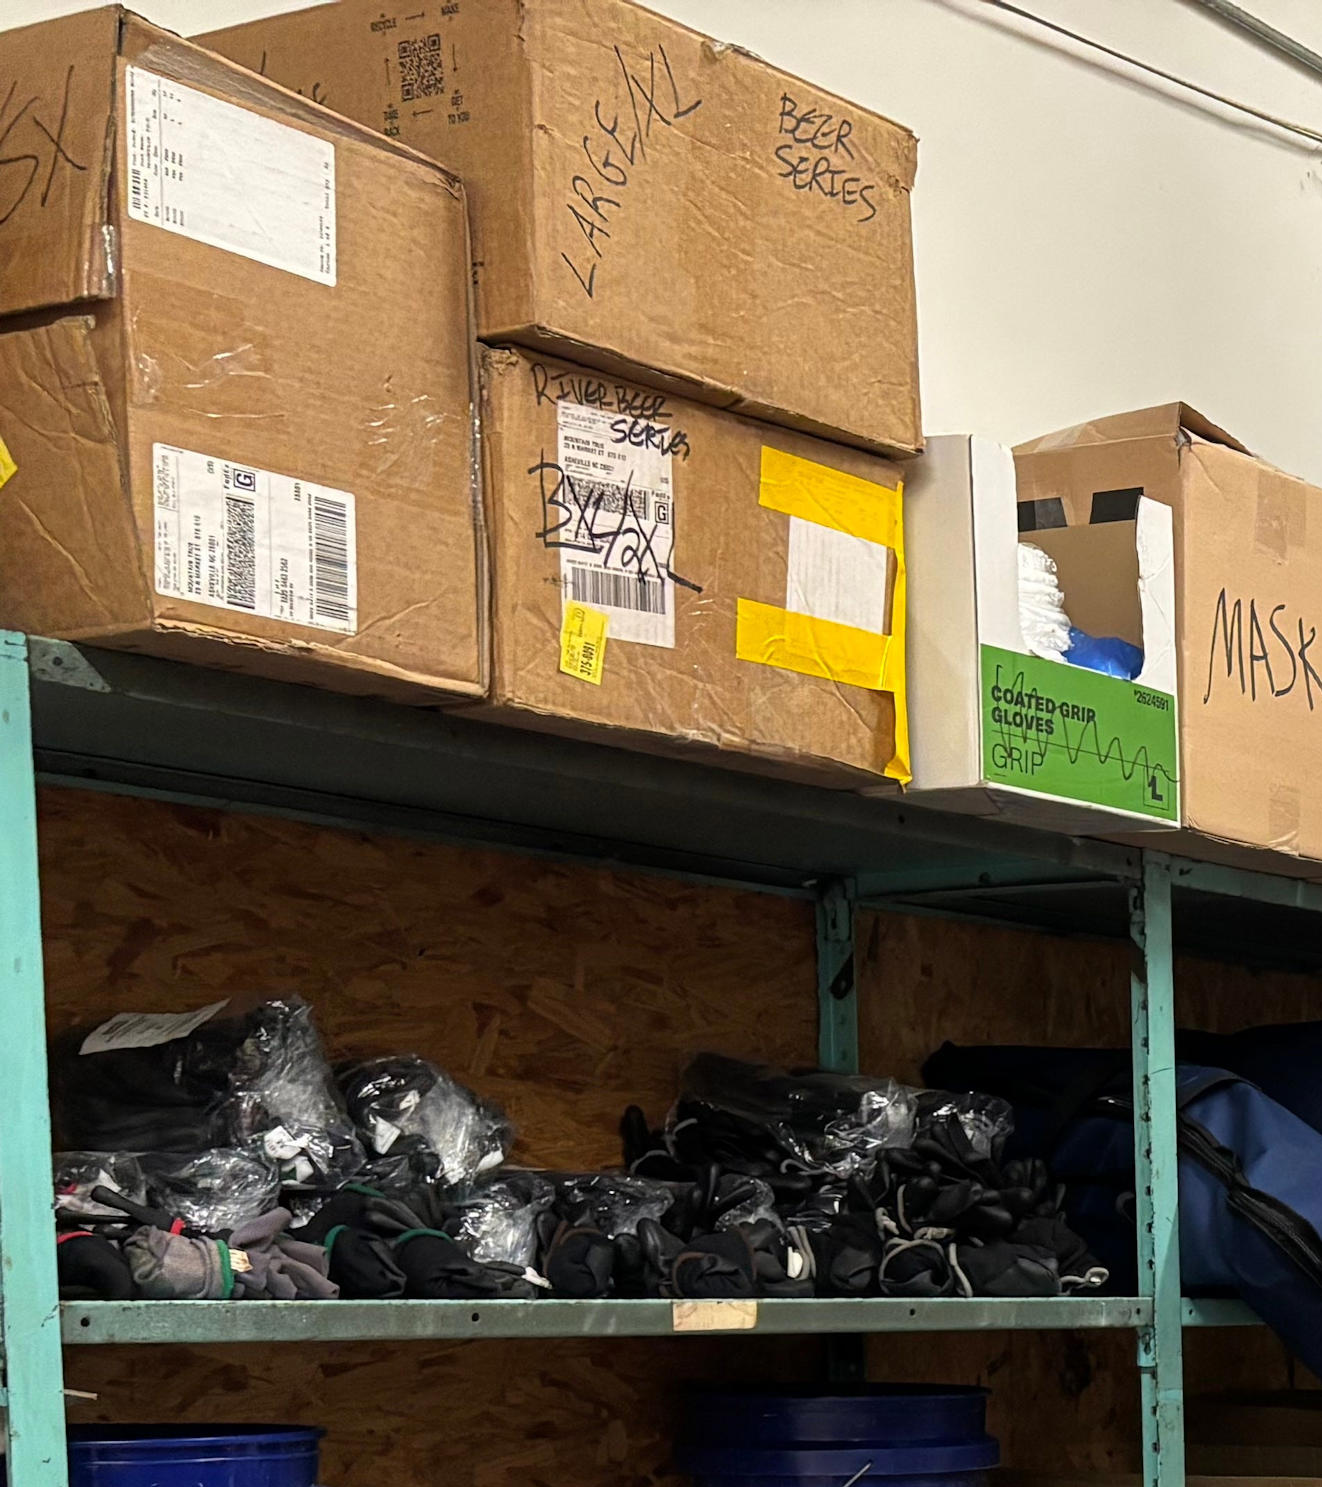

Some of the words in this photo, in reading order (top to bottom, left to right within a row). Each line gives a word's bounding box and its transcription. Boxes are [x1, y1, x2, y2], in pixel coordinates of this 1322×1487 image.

[779, 93, 856, 160] BEER
[775, 145, 877, 222] SERIES
[614, 384, 673, 419] BEER
[236, 472, 253, 488] G
[657, 504, 667, 521] G
[991, 685, 1056, 714] COATED
[1059, 702, 1096, 724] GRIP
[991, 707, 1055, 735] GLOVES
[991, 743, 1044, 776] GRIP
